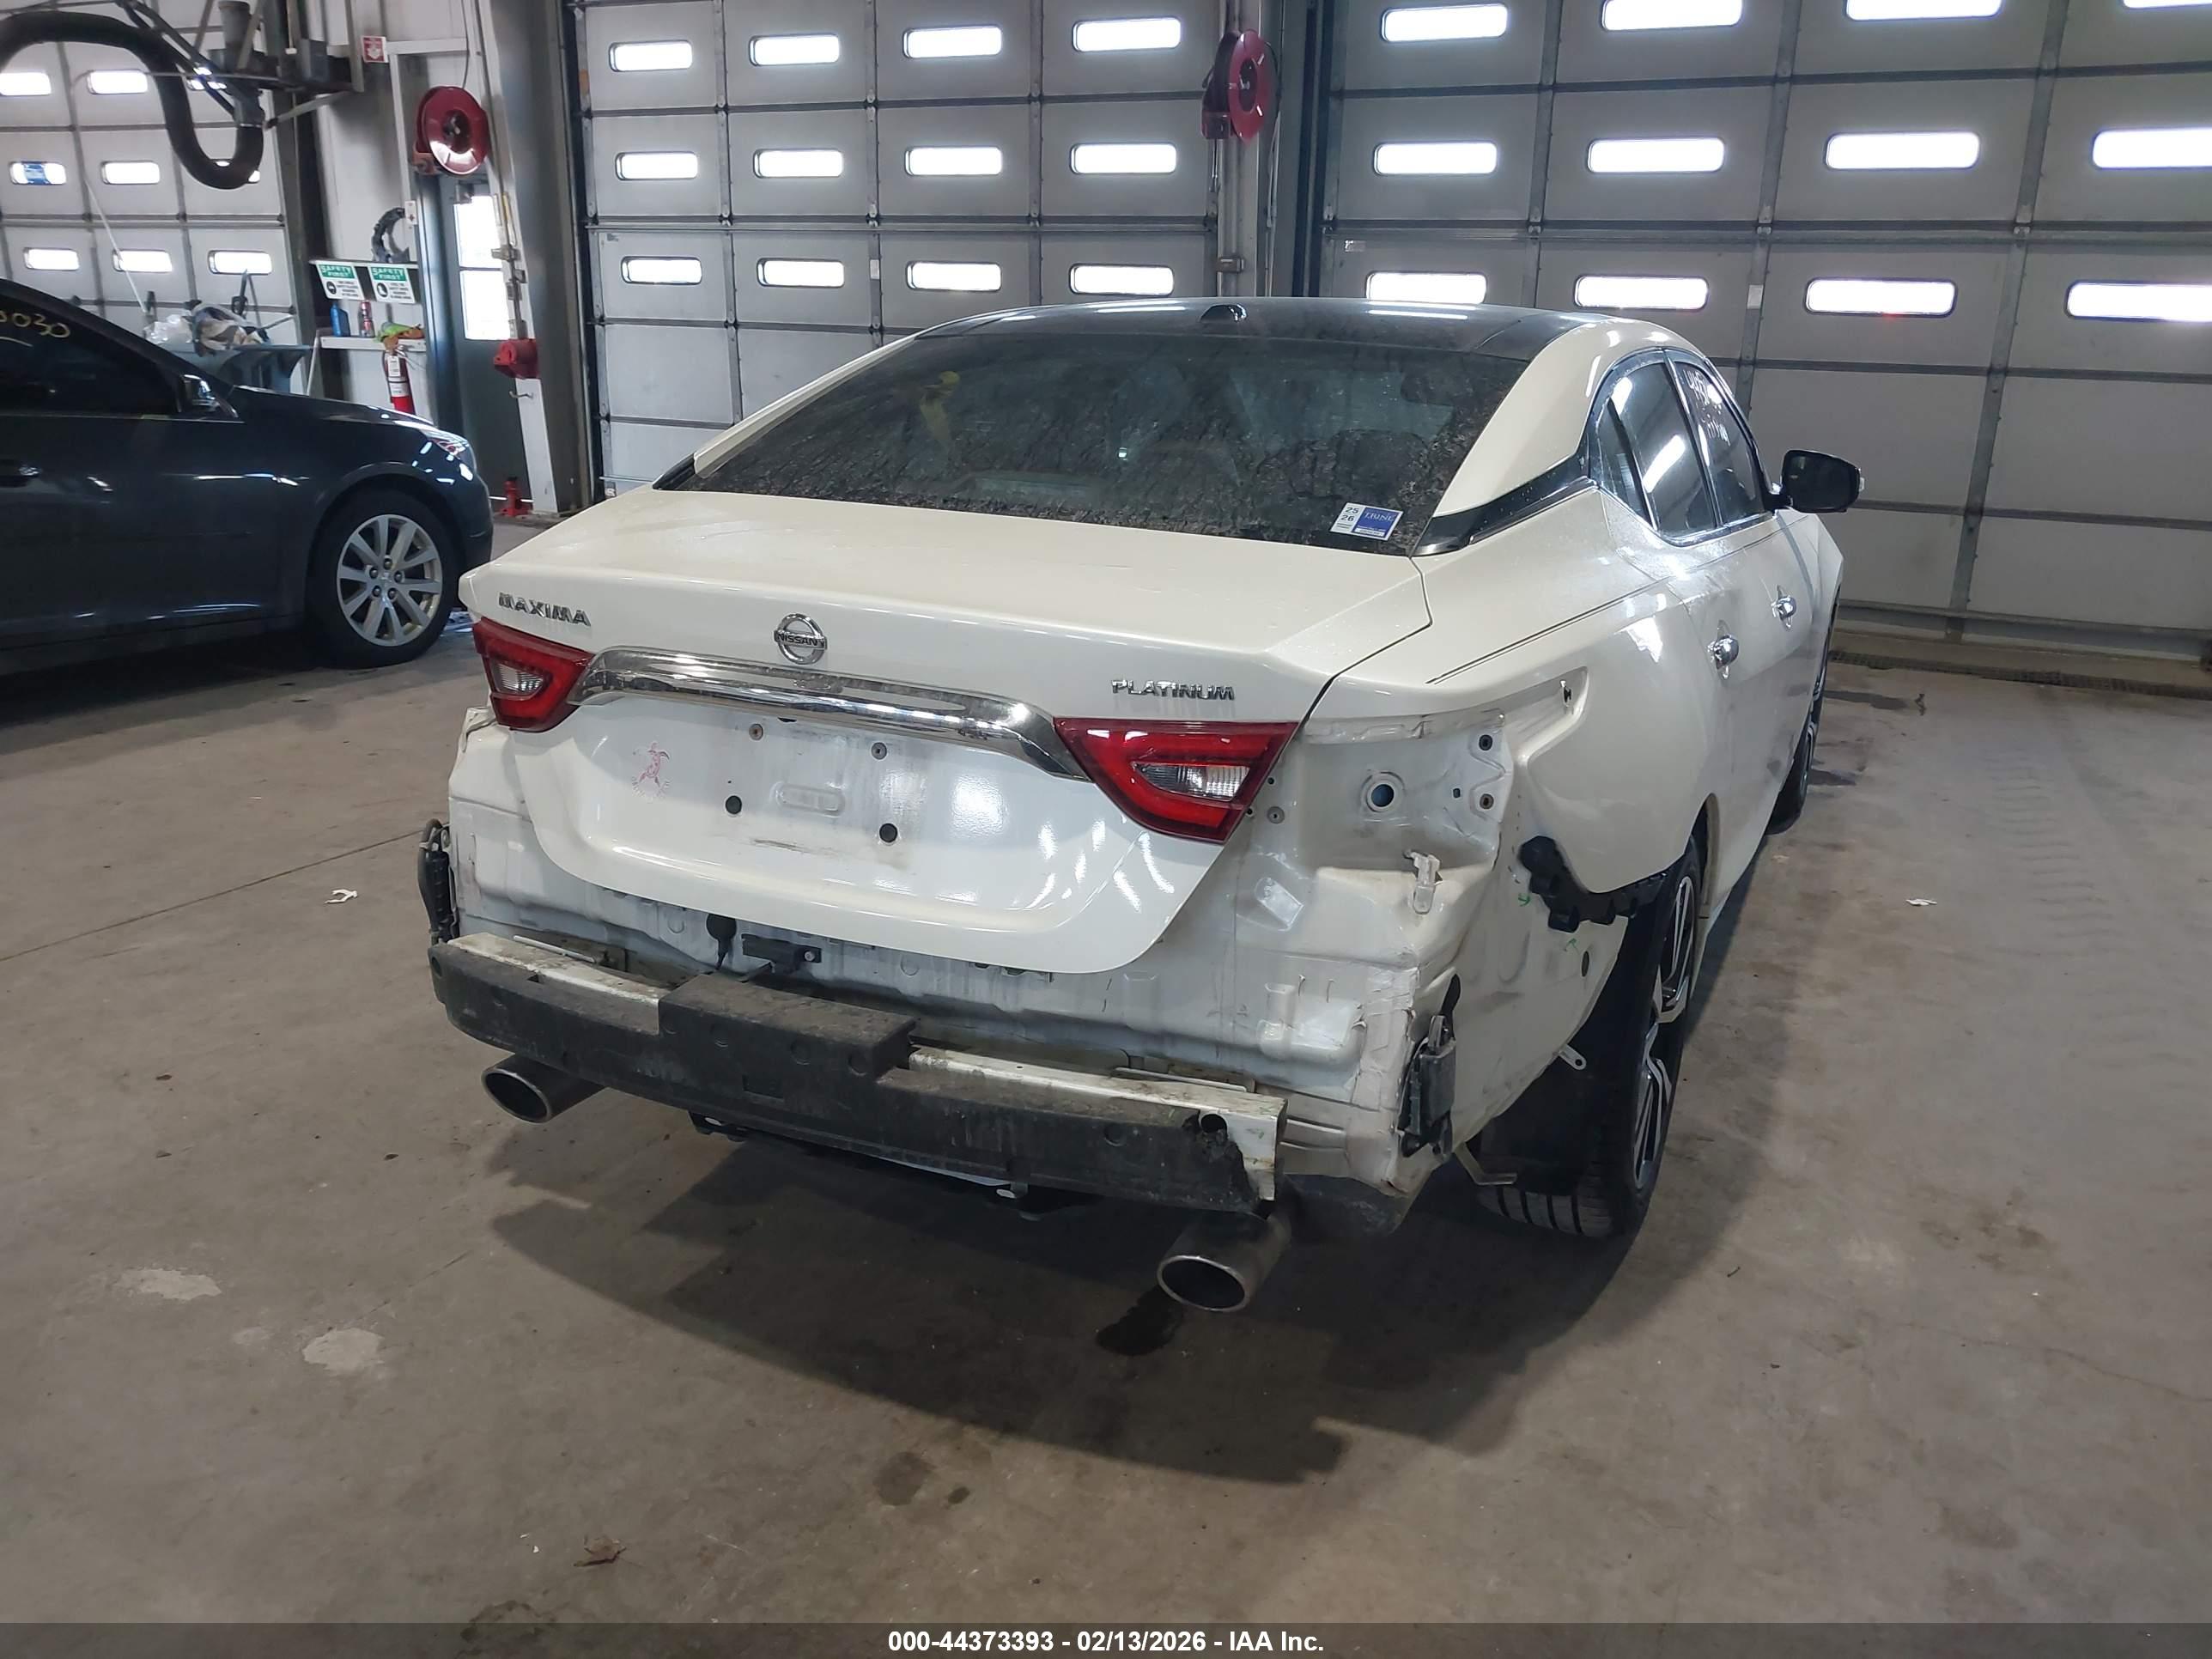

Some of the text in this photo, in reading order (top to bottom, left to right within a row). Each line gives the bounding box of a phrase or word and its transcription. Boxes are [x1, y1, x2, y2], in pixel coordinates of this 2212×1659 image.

[319, 264, 352, 274] SAFETY
[372, 266, 404, 276] SAFETY
[499, 592, 591, 627] MAXIMA
[777, 634, 818, 646] NISSAN
[1112, 679, 1235, 701] PLATINUM
